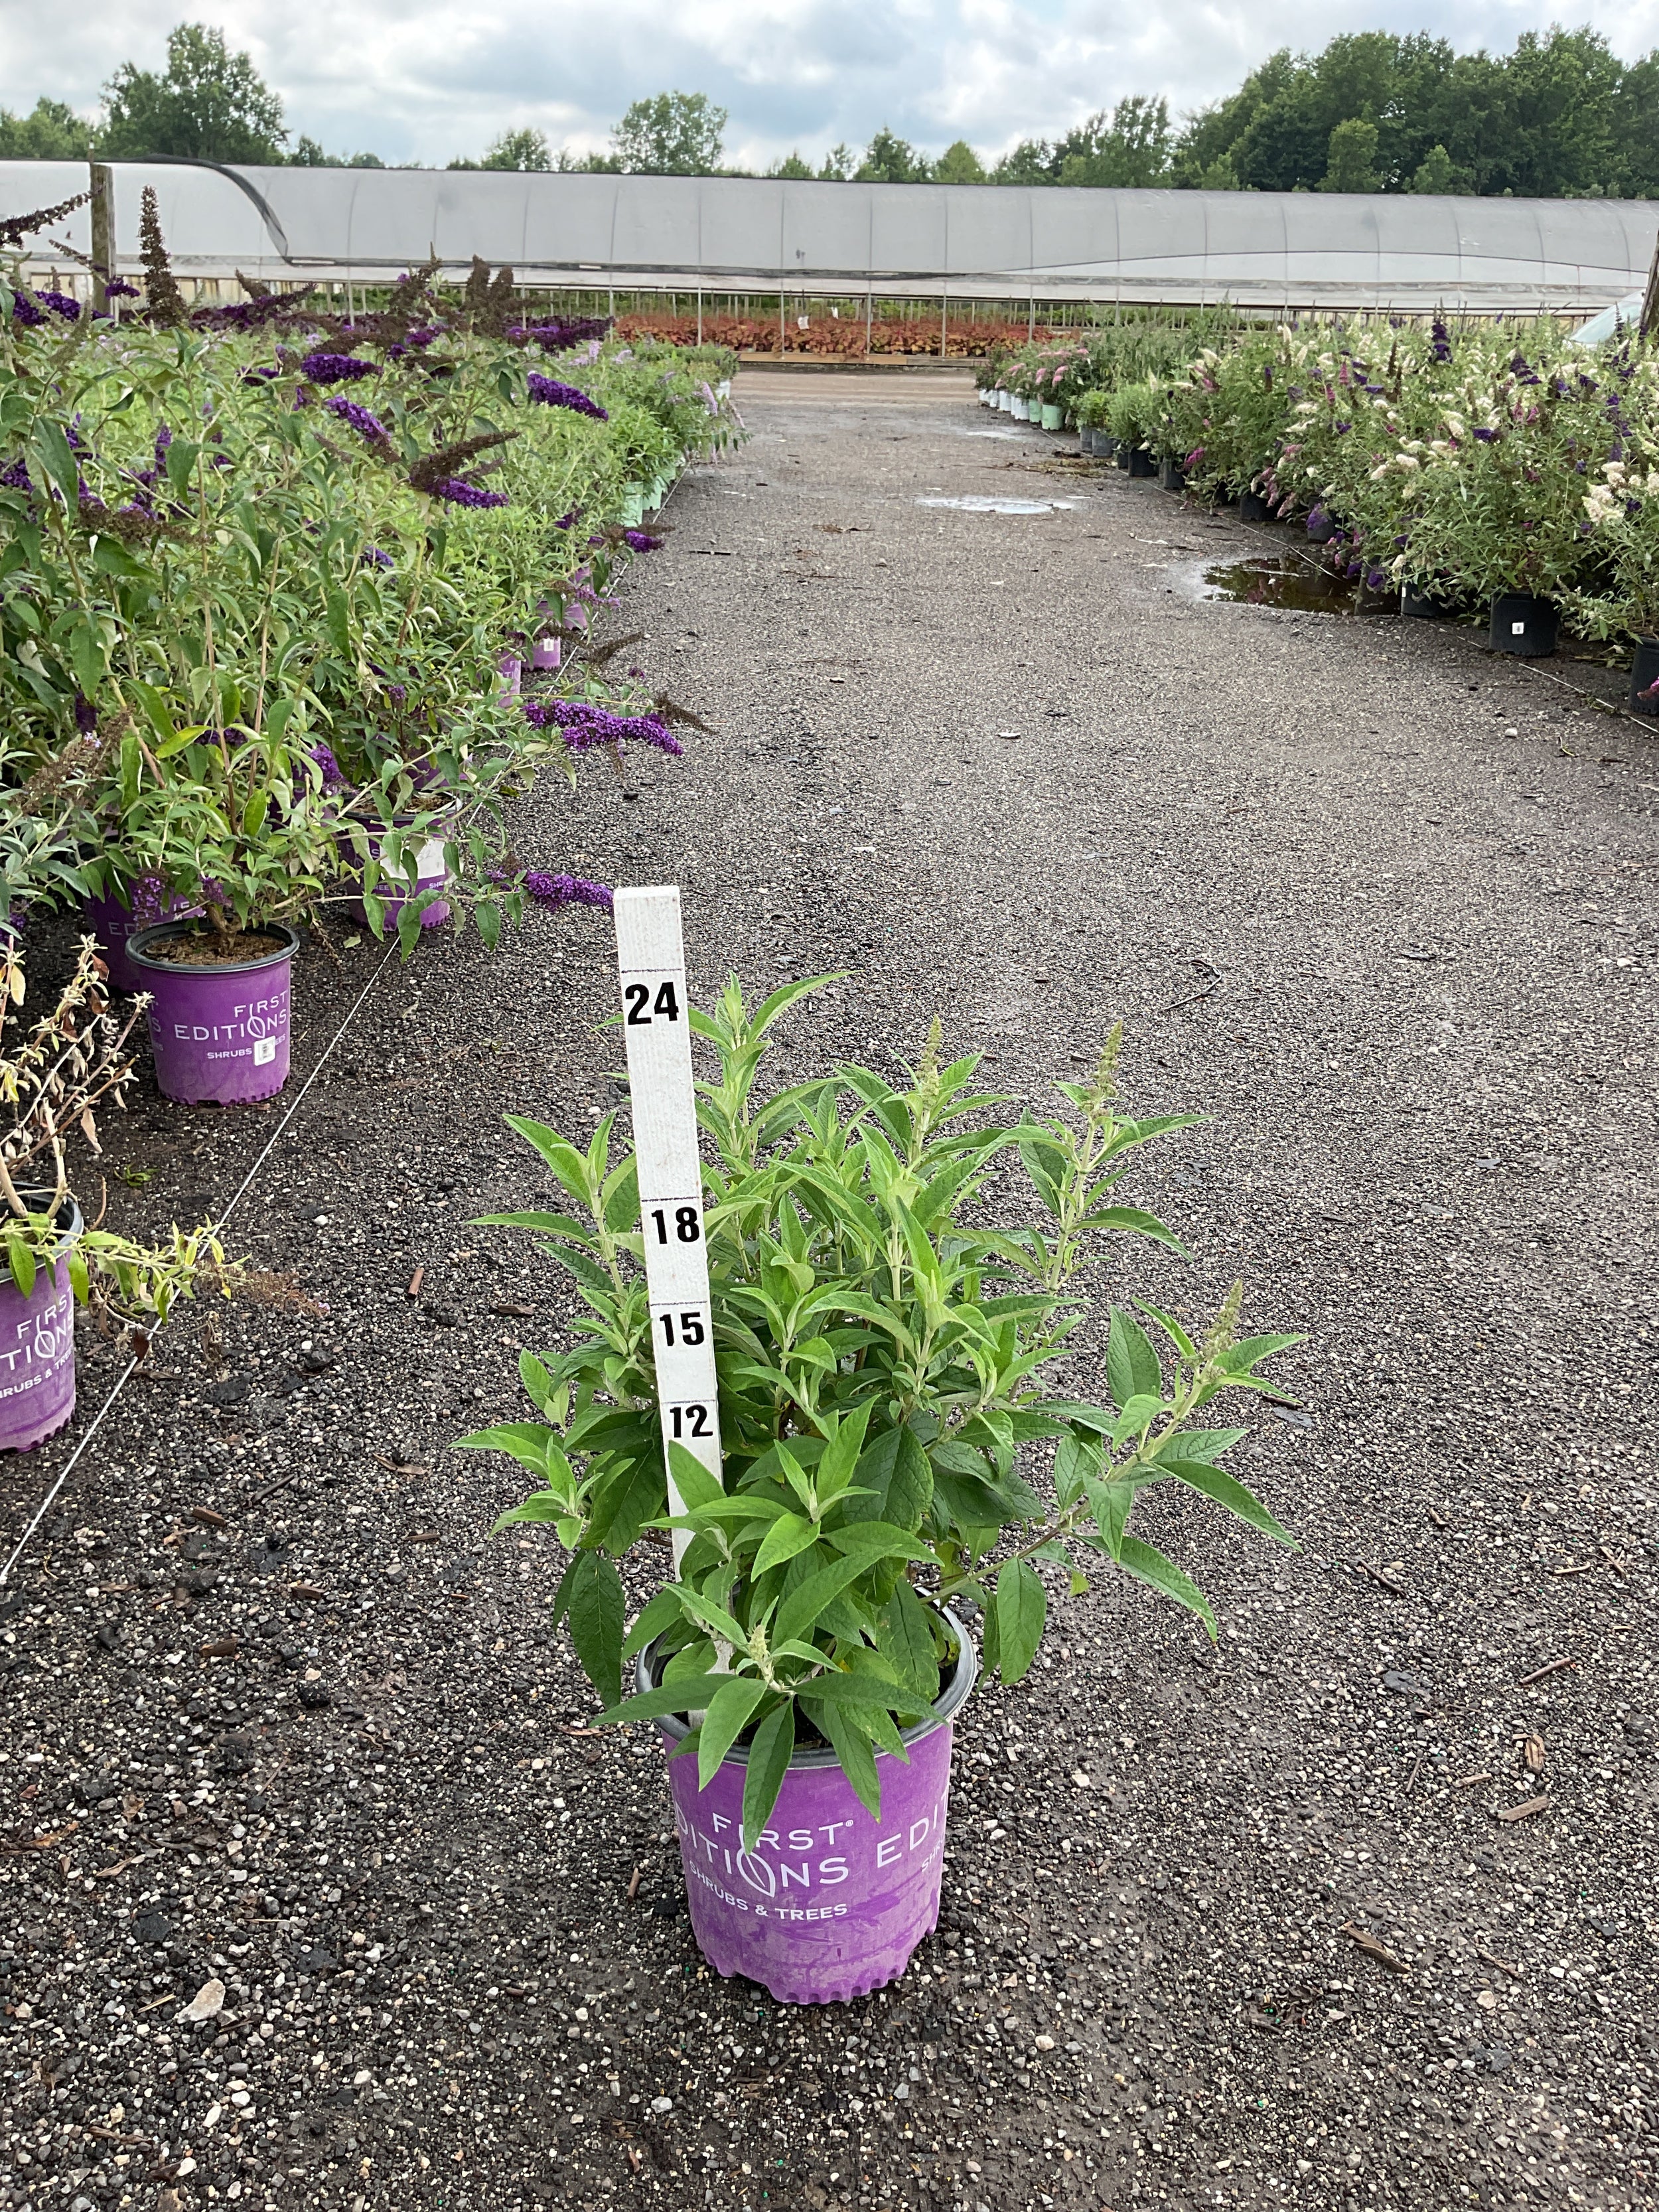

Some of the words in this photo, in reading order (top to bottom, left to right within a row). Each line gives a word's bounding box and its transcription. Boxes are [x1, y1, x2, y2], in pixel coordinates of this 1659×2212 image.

[234, 991, 287, 1017] FIRST
[625, 982, 679, 1025] 24
[175, 1009, 287, 1040] EDITIONS
[207, 1048, 253, 1059] SHRUBS
[651, 1207, 700, 1244] 18
[0, 1307, 74, 1370] TIONS
[660, 1311, 704, 1346] 15
[0, 1374, 42, 1399] RUBS
[45, 1368, 52, 1378] &
[670, 1404, 713, 1438] 12
[676, 1801, 849, 1897] DITIONS
[877, 1787, 948, 1868] EDIT
[689, 1860, 749, 1911] SHRUBS
[755, 1903, 768, 1917] &
[774, 1903, 847, 1921] TREES
